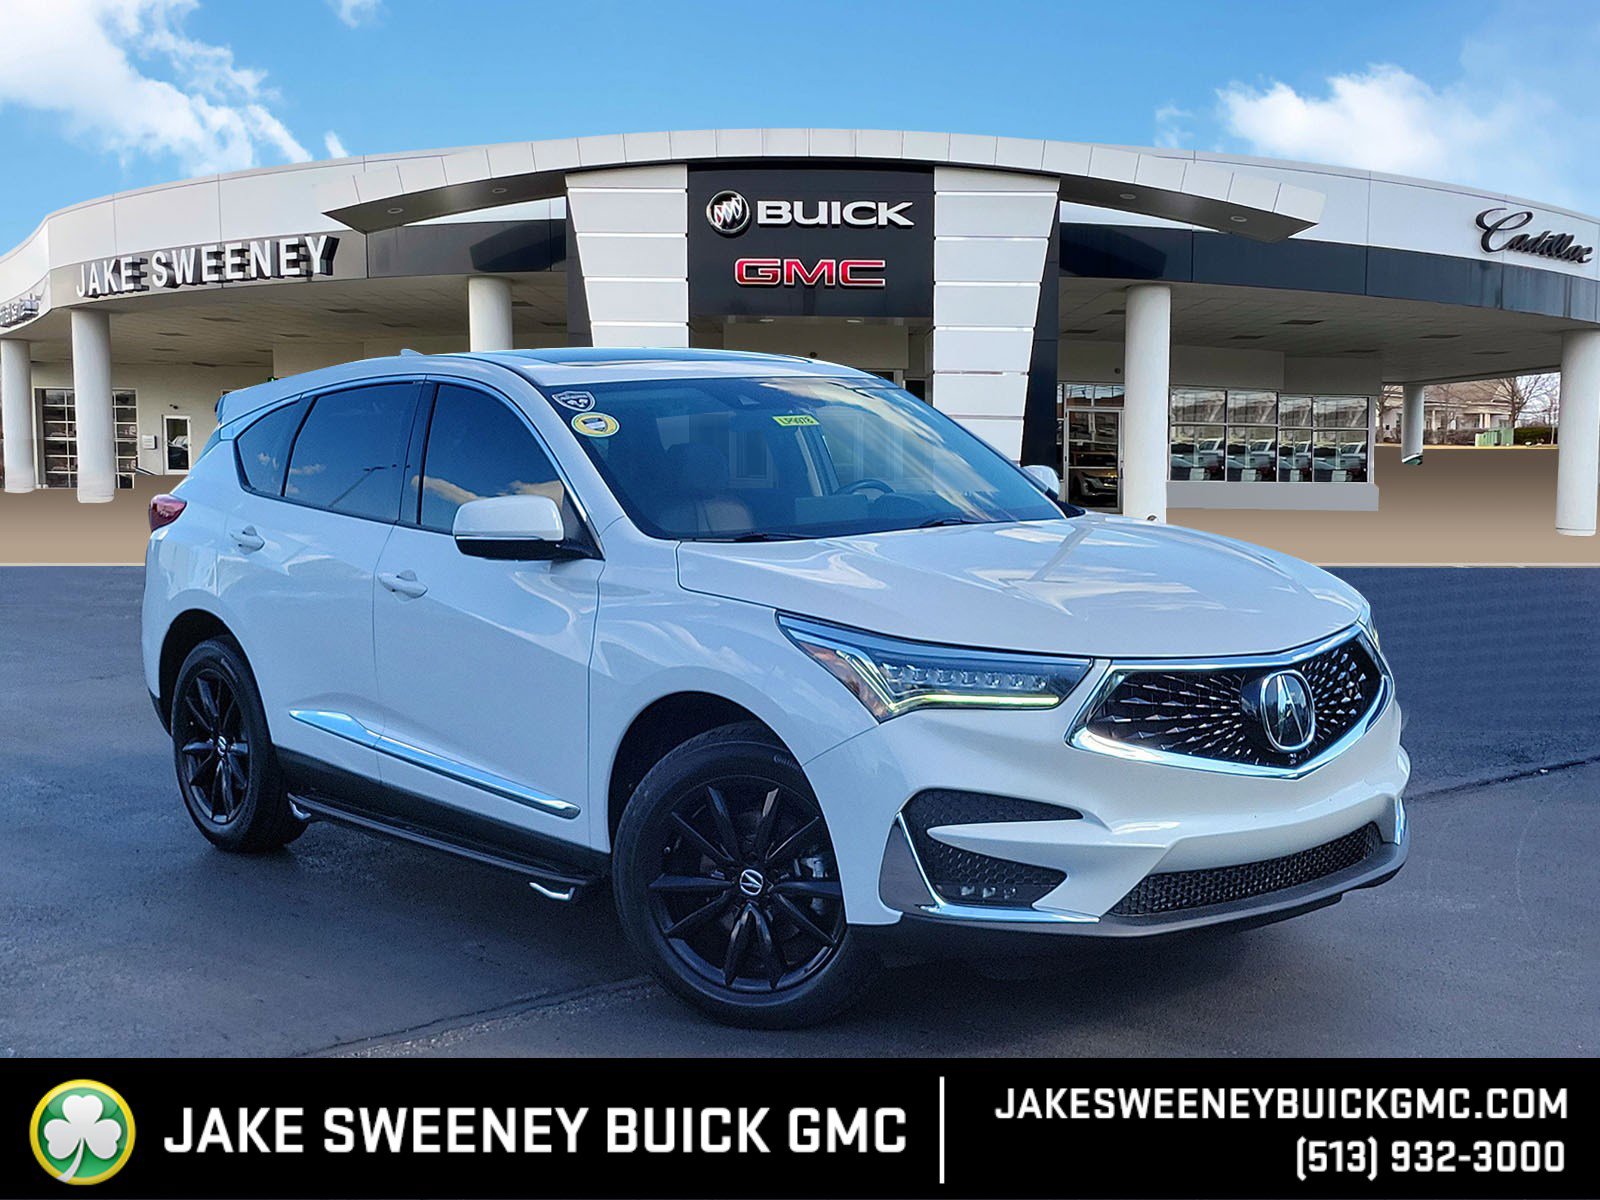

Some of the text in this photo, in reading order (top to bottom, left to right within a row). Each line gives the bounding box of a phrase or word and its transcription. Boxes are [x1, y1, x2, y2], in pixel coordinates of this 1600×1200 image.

[757, 200, 915, 226] BUICK
[1475, 207, 1593, 264] Cadillac
[76, 234, 334, 299] JAKE SWEENEY
[733, 257, 886, 287] GMC
